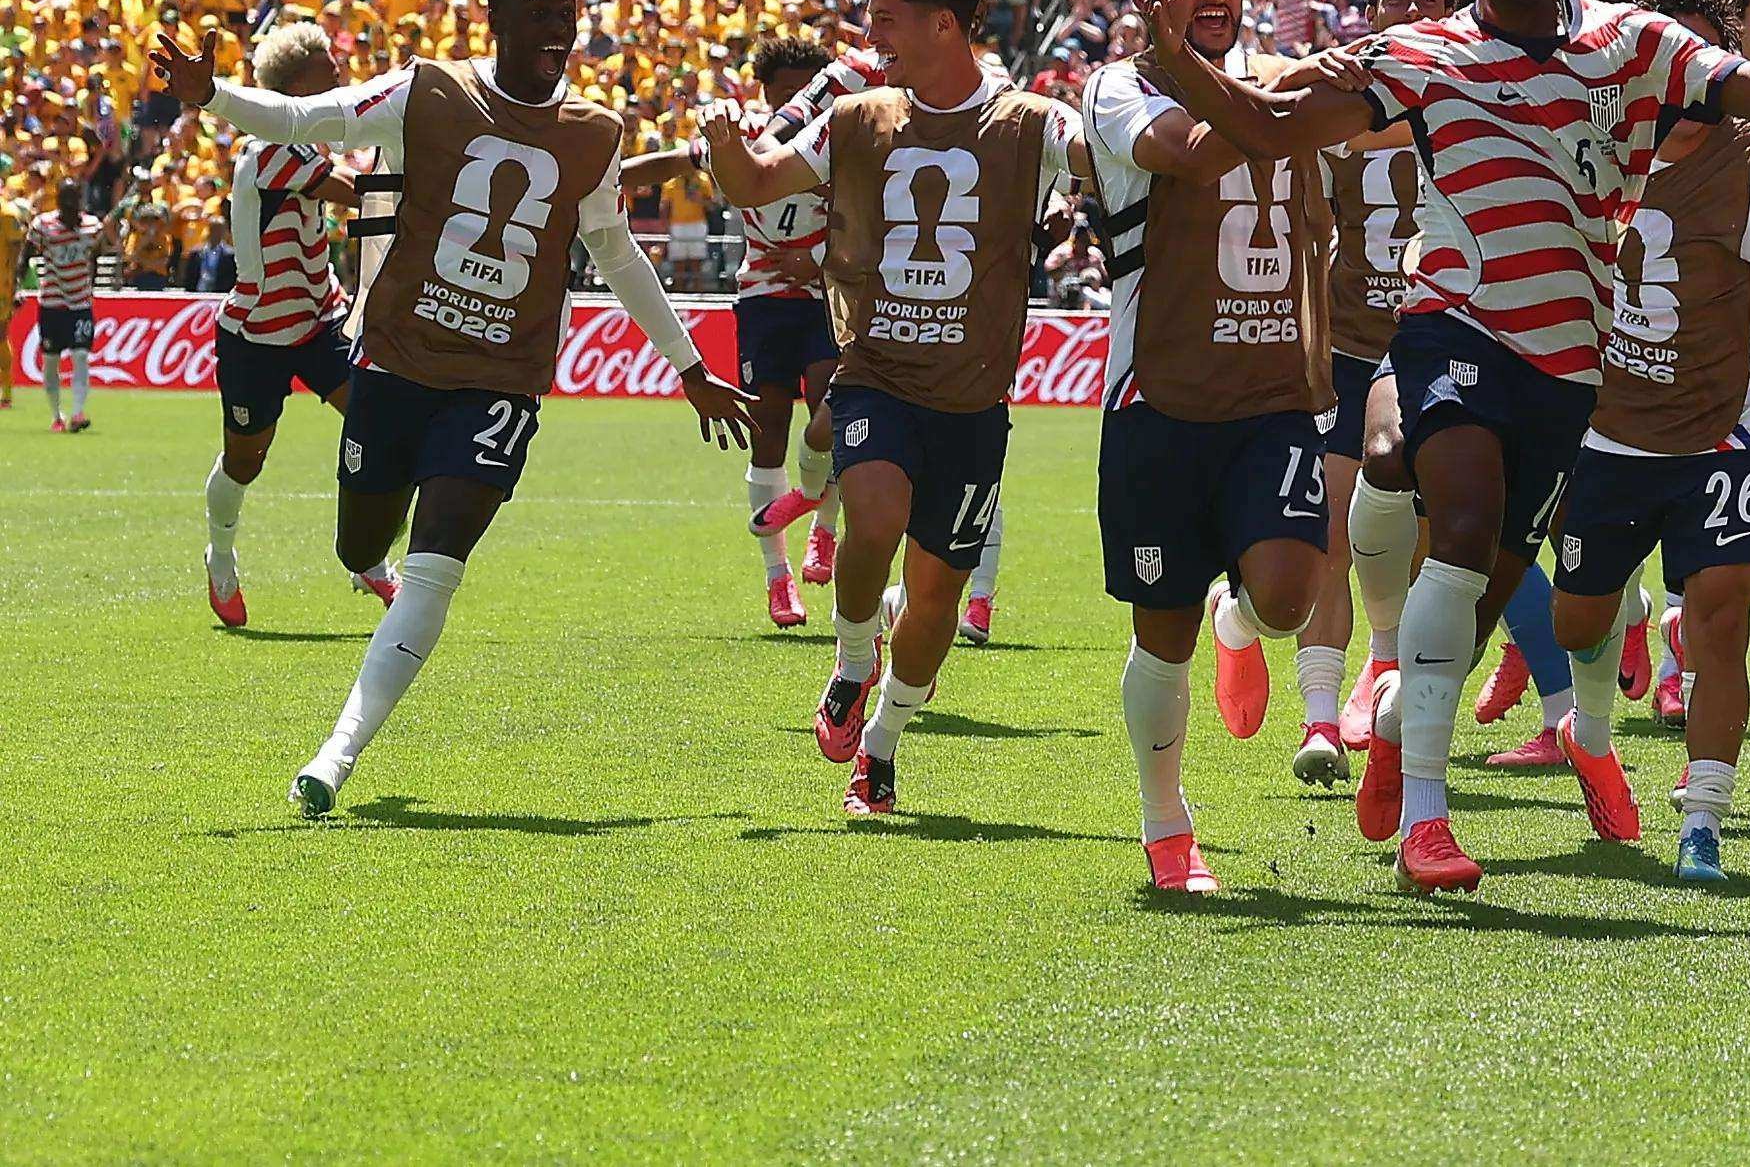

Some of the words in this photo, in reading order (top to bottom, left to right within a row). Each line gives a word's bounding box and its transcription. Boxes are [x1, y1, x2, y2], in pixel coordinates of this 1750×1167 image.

[1590, 85, 1618, 107] USA
[777, 202, 798, 236] 4
[460, 258, 503, 285] FIFA
[904, 268, 946, 286] FIFA
[1246, 257, 1280, 275] FIFA
[1365, 276, 1406, 288] WOR
[422, 281, 482, 312] WORLD
[484, 304, 517, 321] CUP
[874, 299, 933, 320] WORLD
[935, 306, 968, 320] CUP
[1216, 299, 1270, 315] WORLD
[1273, 298, 1293, 315] CUP
[1366, 289, 1404, 308] 20
[413, 297, 512, 344] 2026
[868, 316, 965, 344] 2026
[1213, 318, 1298, 344] 2026
[1608, 333, 1640, 356] ORLD
[1643, 347, 1679, 363] CUP
[1451, 361, 1477, 374] USA
[1605, 345, 1675, 384] 026
[473, 400, 530, 456] 21
[1279, 446, 1325, 505] 15
[952, 482, 999, 534] 14
[1135, 548, 1161, 564] USA
